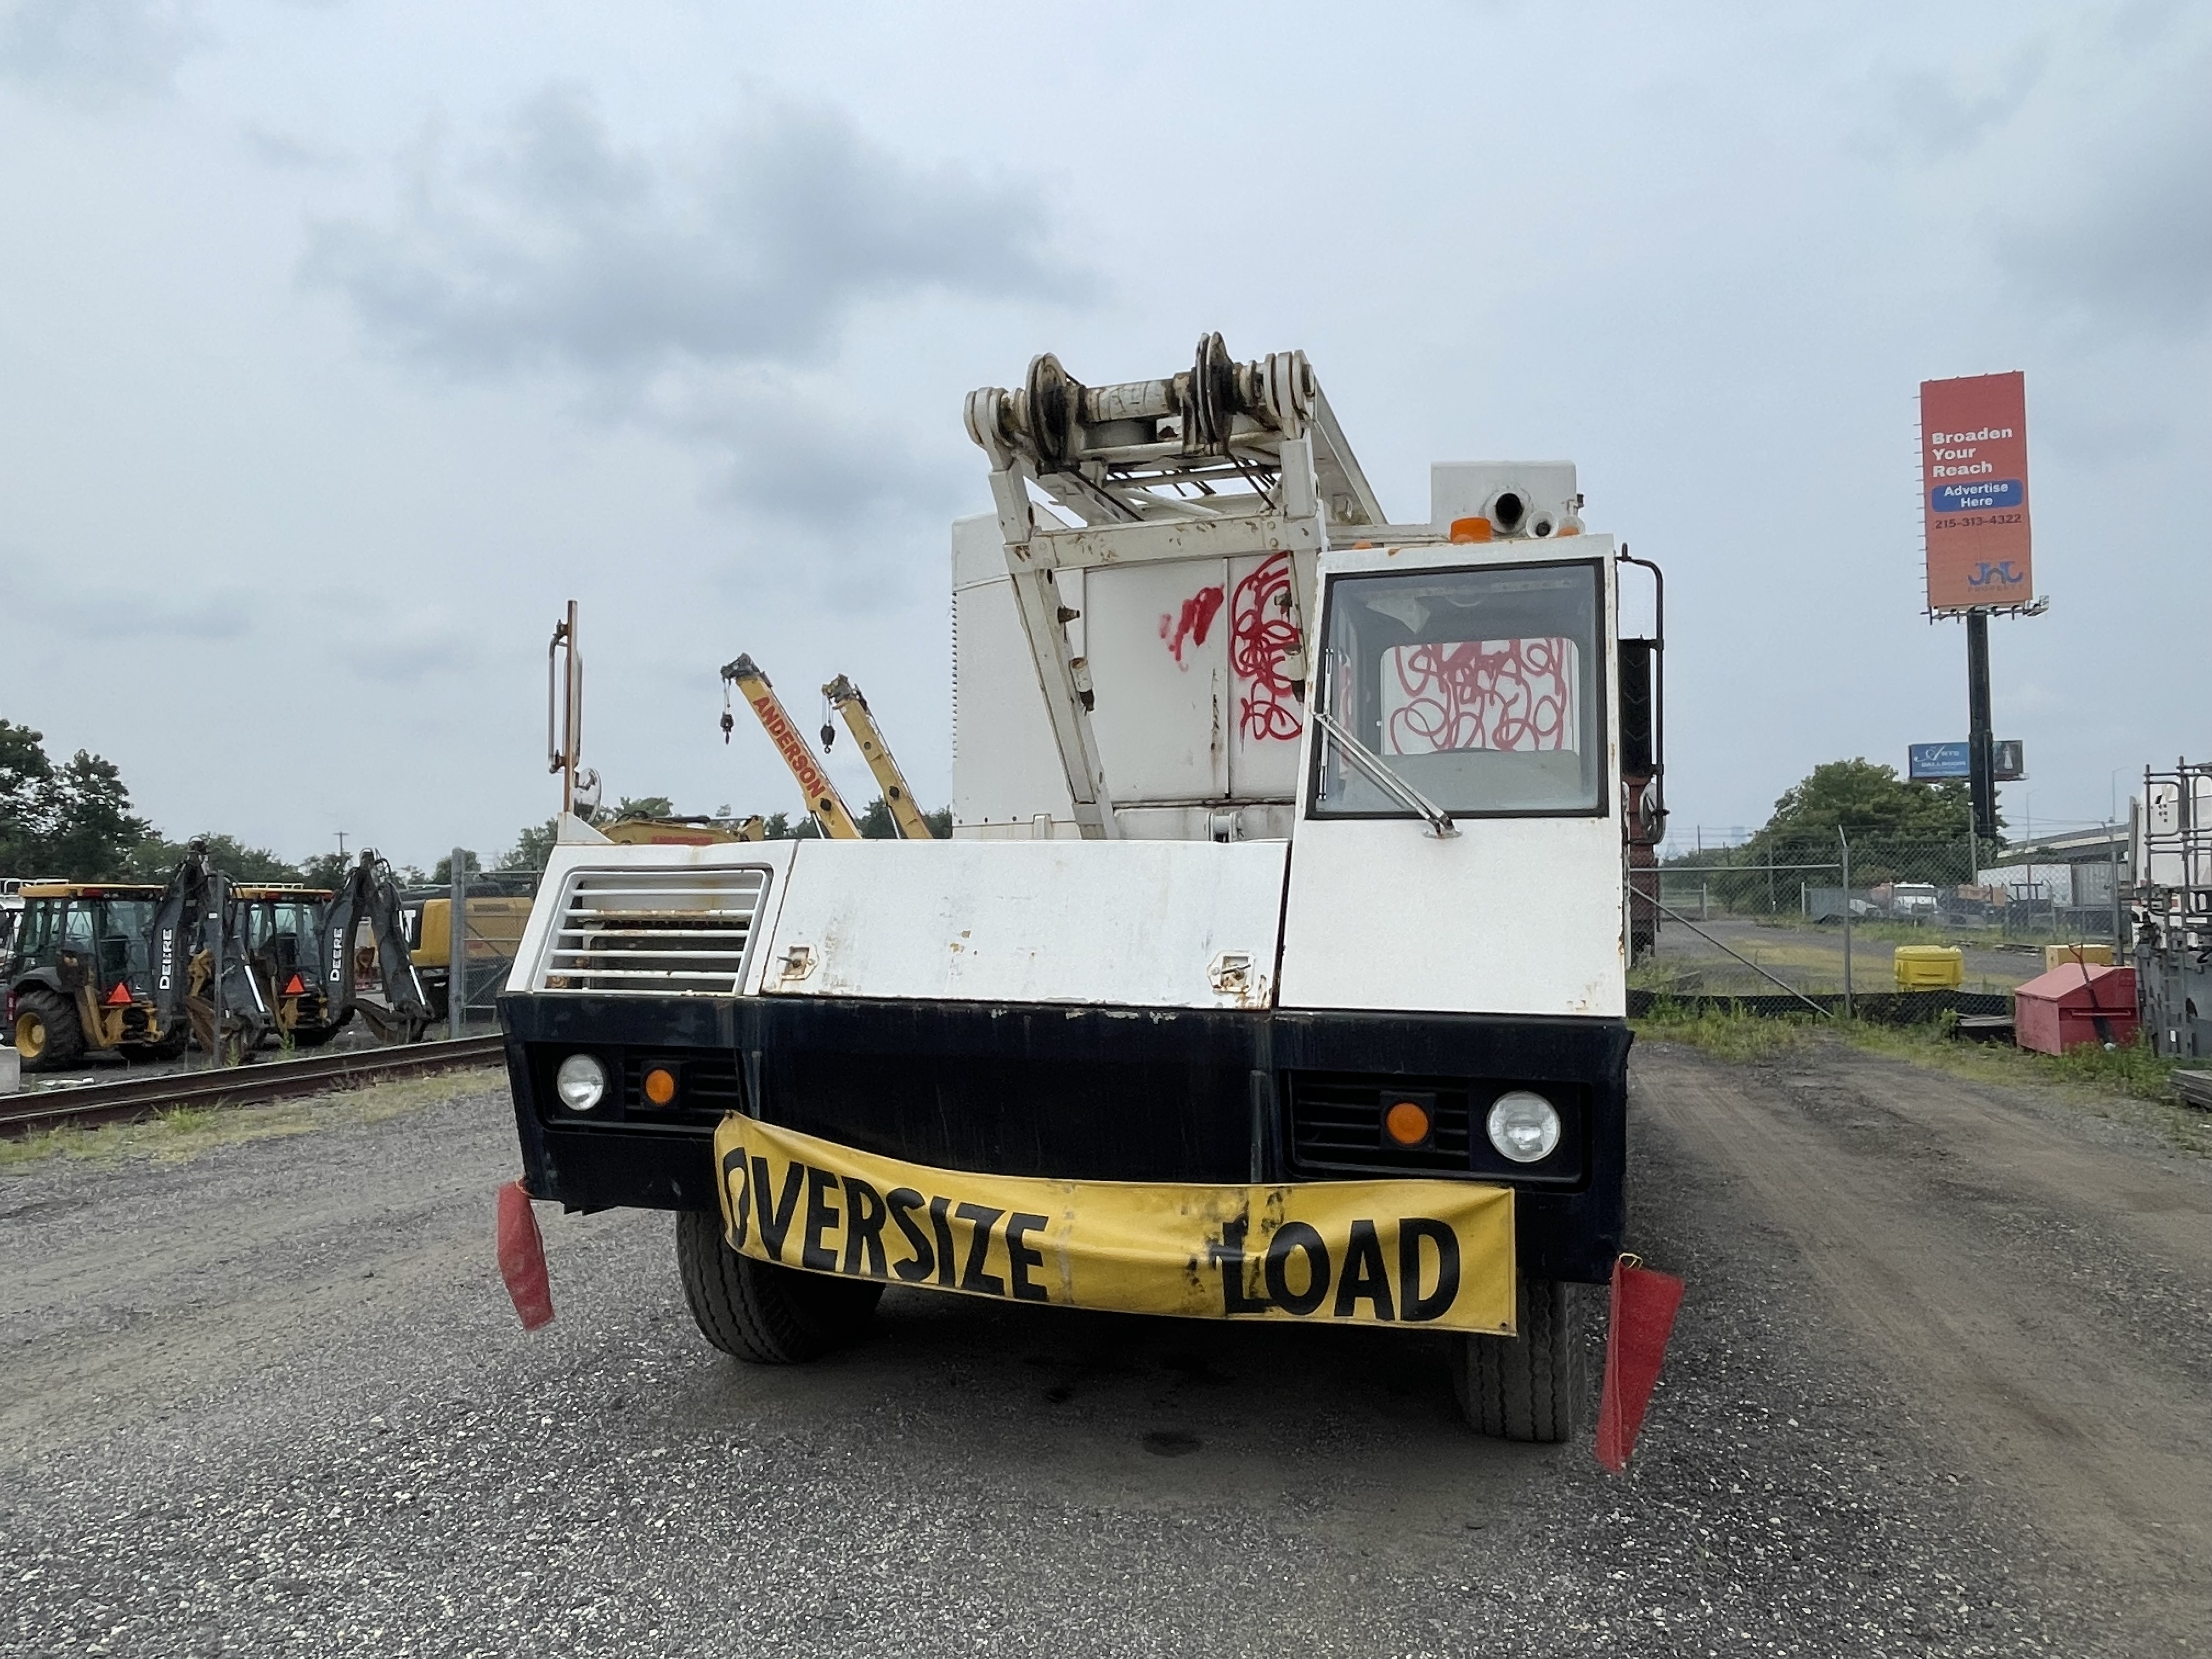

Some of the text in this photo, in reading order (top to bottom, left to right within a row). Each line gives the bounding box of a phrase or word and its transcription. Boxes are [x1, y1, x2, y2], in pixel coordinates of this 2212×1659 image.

[1932, 427, 2012, 444] Broaden
[1932, 448, 1976, 461] Your
[1933, 461, 1993, 477] Reach
[1944, 483, 2009, 496] Advertise
[1961, 497, 1993, 508] Here
[1936, 514, 2022, 529] 215-313-4322
[752, 697, 825, 798] ANDERSON
[159, 928, 172, 990] DEERE
[330, 928, 342, 981] DEERE
[723, 1147, 1460, 1321] OVERSIZE LOAD
